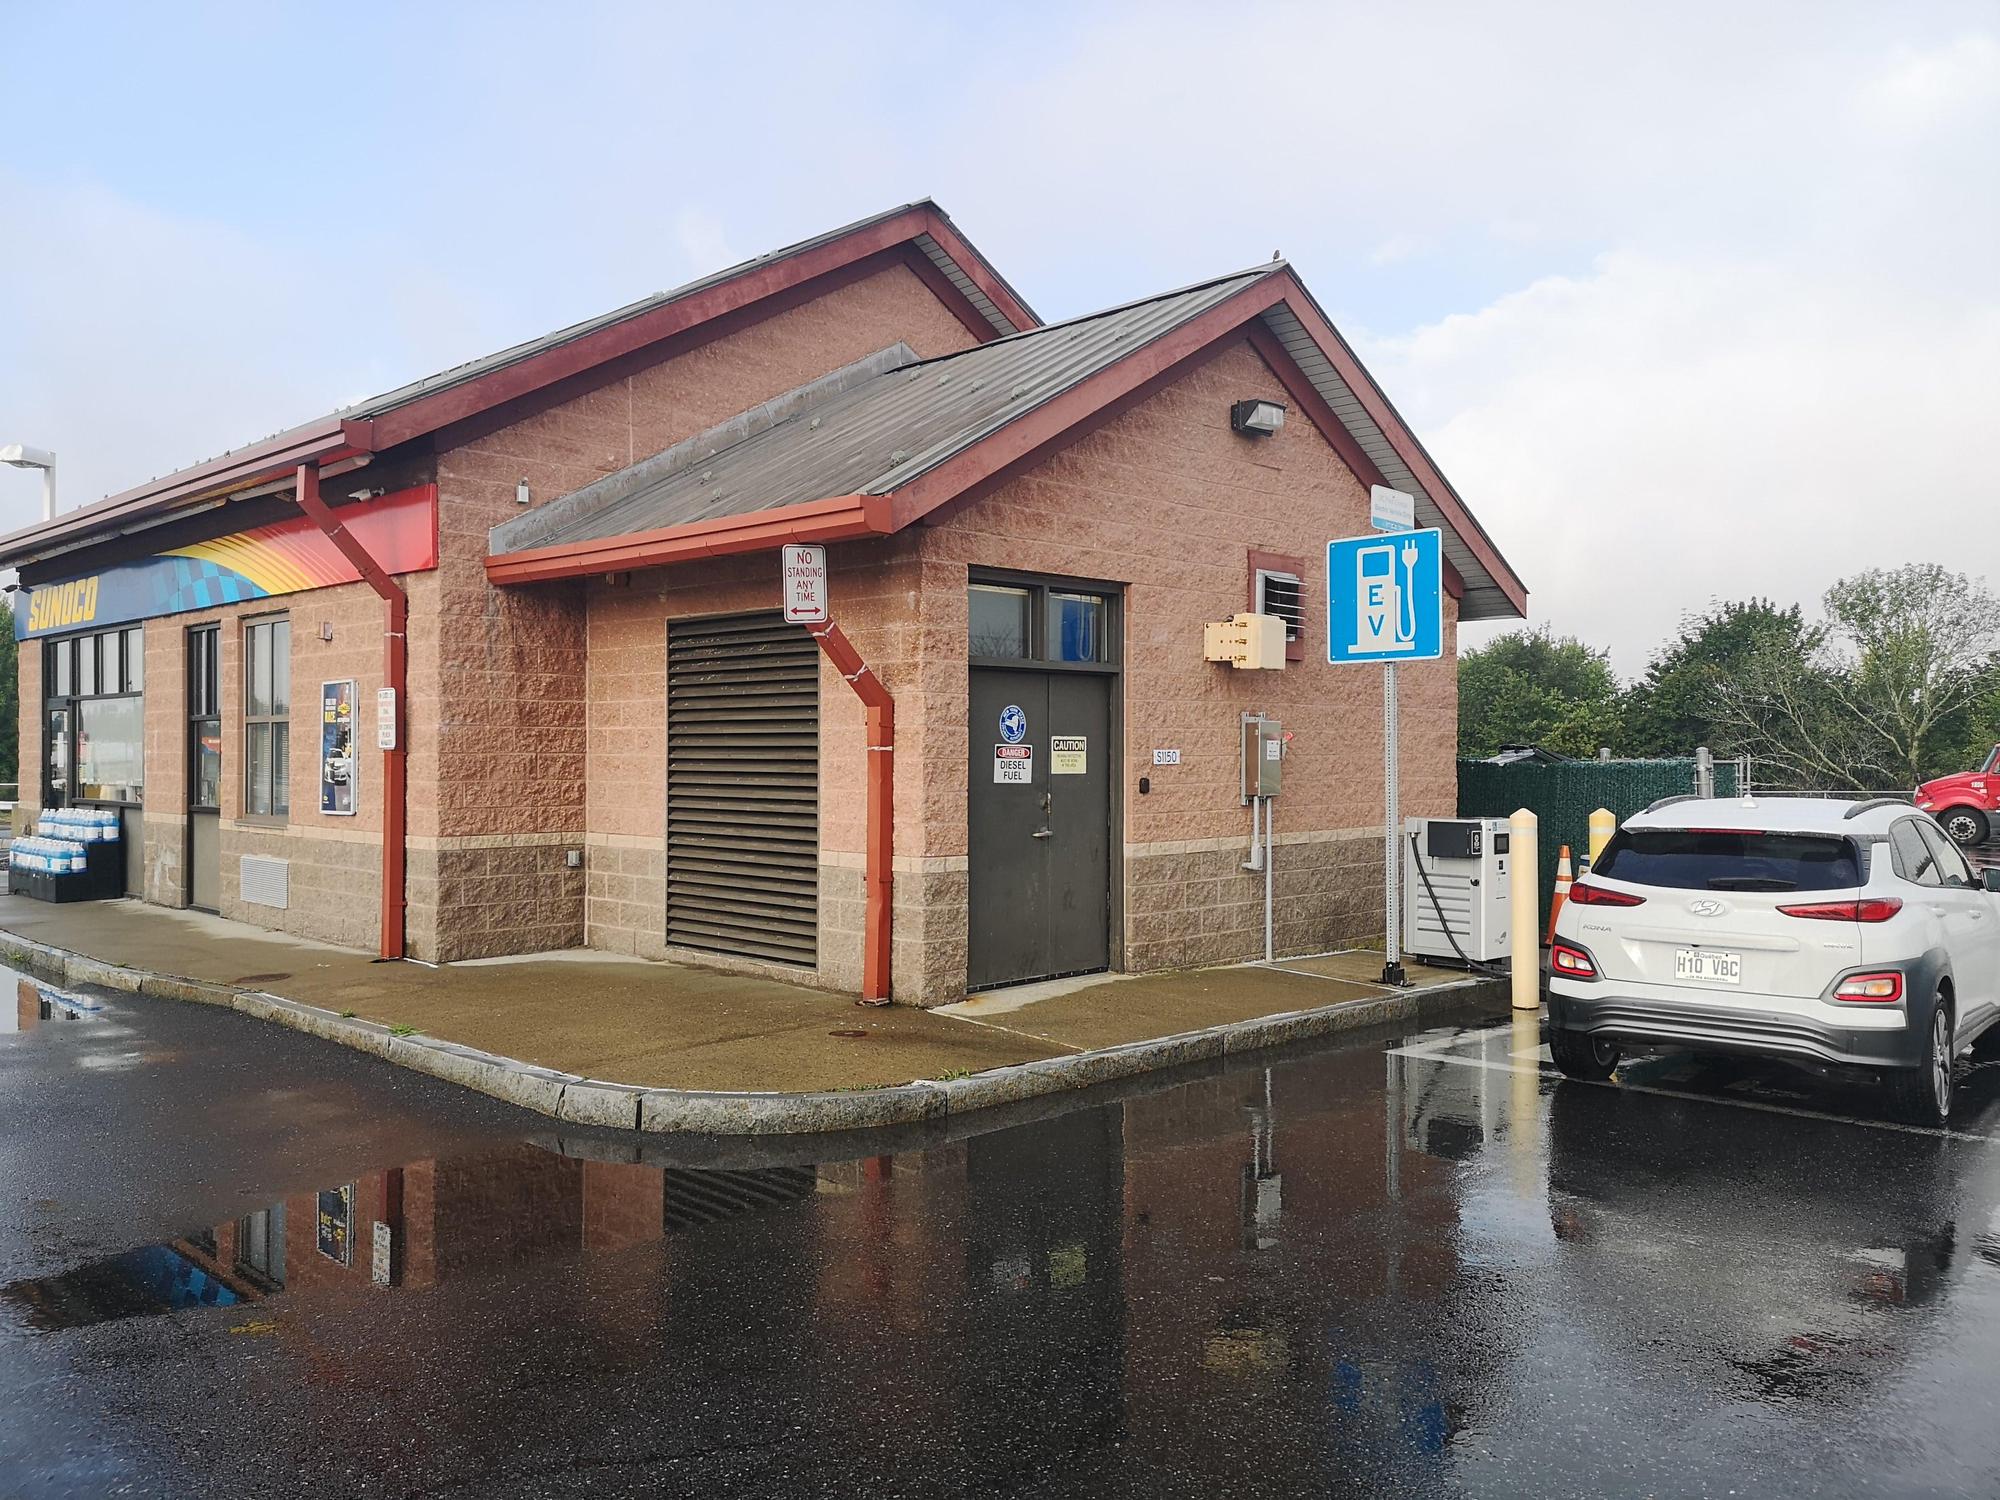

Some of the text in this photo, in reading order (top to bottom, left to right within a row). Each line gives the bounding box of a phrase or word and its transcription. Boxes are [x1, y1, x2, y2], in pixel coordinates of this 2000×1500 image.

[797, 552, 812, 564] NO
[787, 567, 823, 578] STANDING
[796, 581, 814, 590] ANY
[796, 592, 815, 602] TIME
[28, 575, 99, 632] SUNOCO
[1053, 740, 1085, 751] CAUTION
[1002, 748, 1025, 757] DANGER
[1000, 760, 1026, 770] DIESEL
[1003, 771, 1022, 780] FUEL
[1677, 956, 1738, 977] H10 VBC
